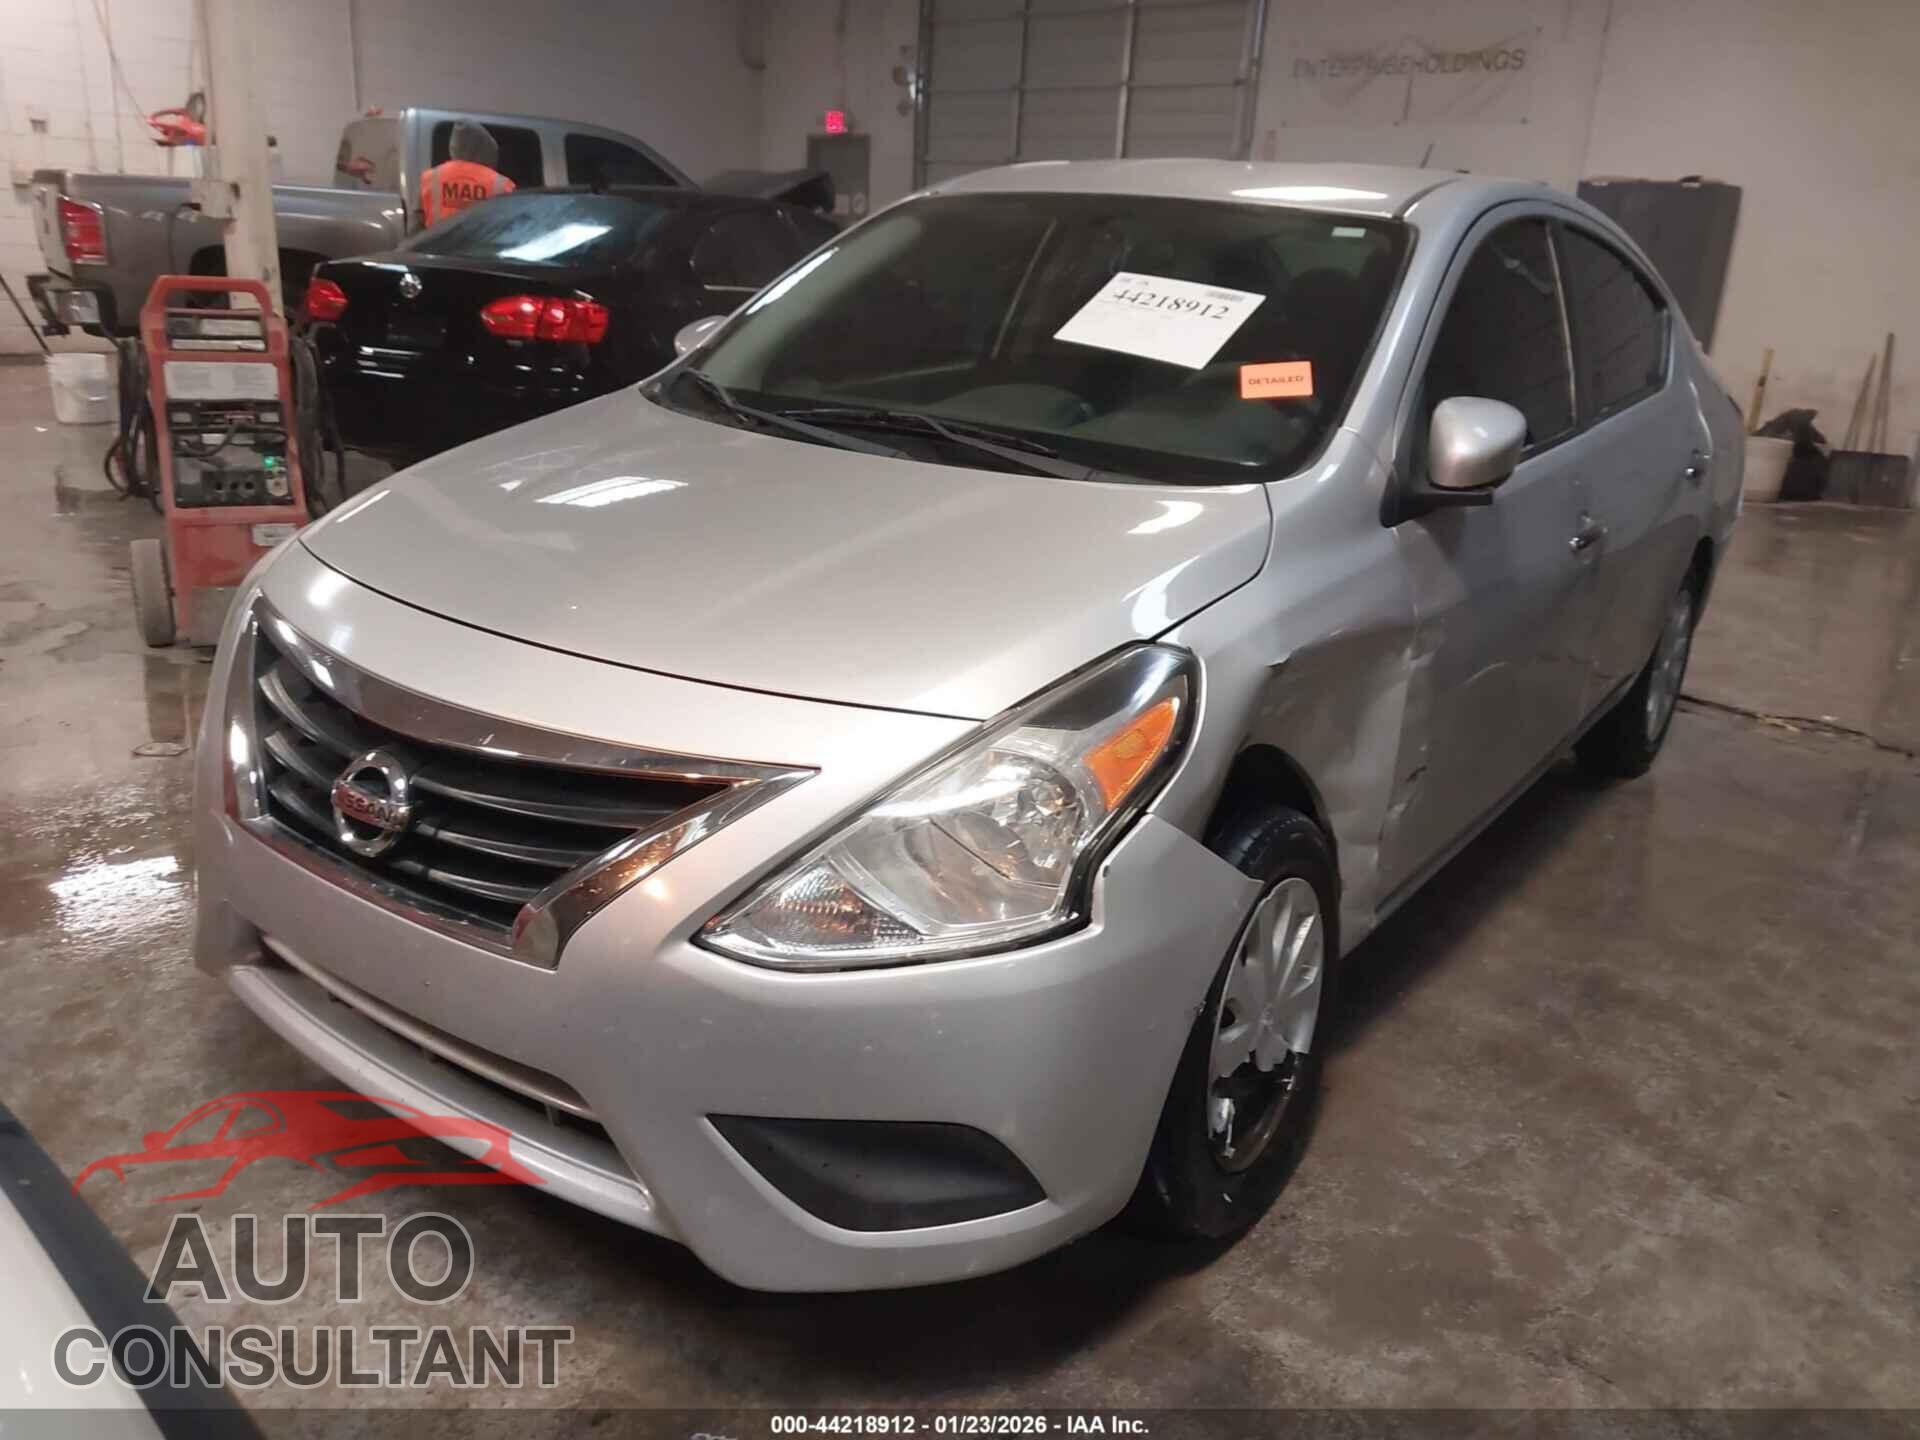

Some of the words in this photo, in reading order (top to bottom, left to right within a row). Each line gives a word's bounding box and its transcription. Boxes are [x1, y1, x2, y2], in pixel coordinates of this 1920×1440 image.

[1411, 49, 1527, 75] HOLDNGS
[1113, 288, 1230, 319] 44218912
[1248, 375, 1304, 385] DETAILED
